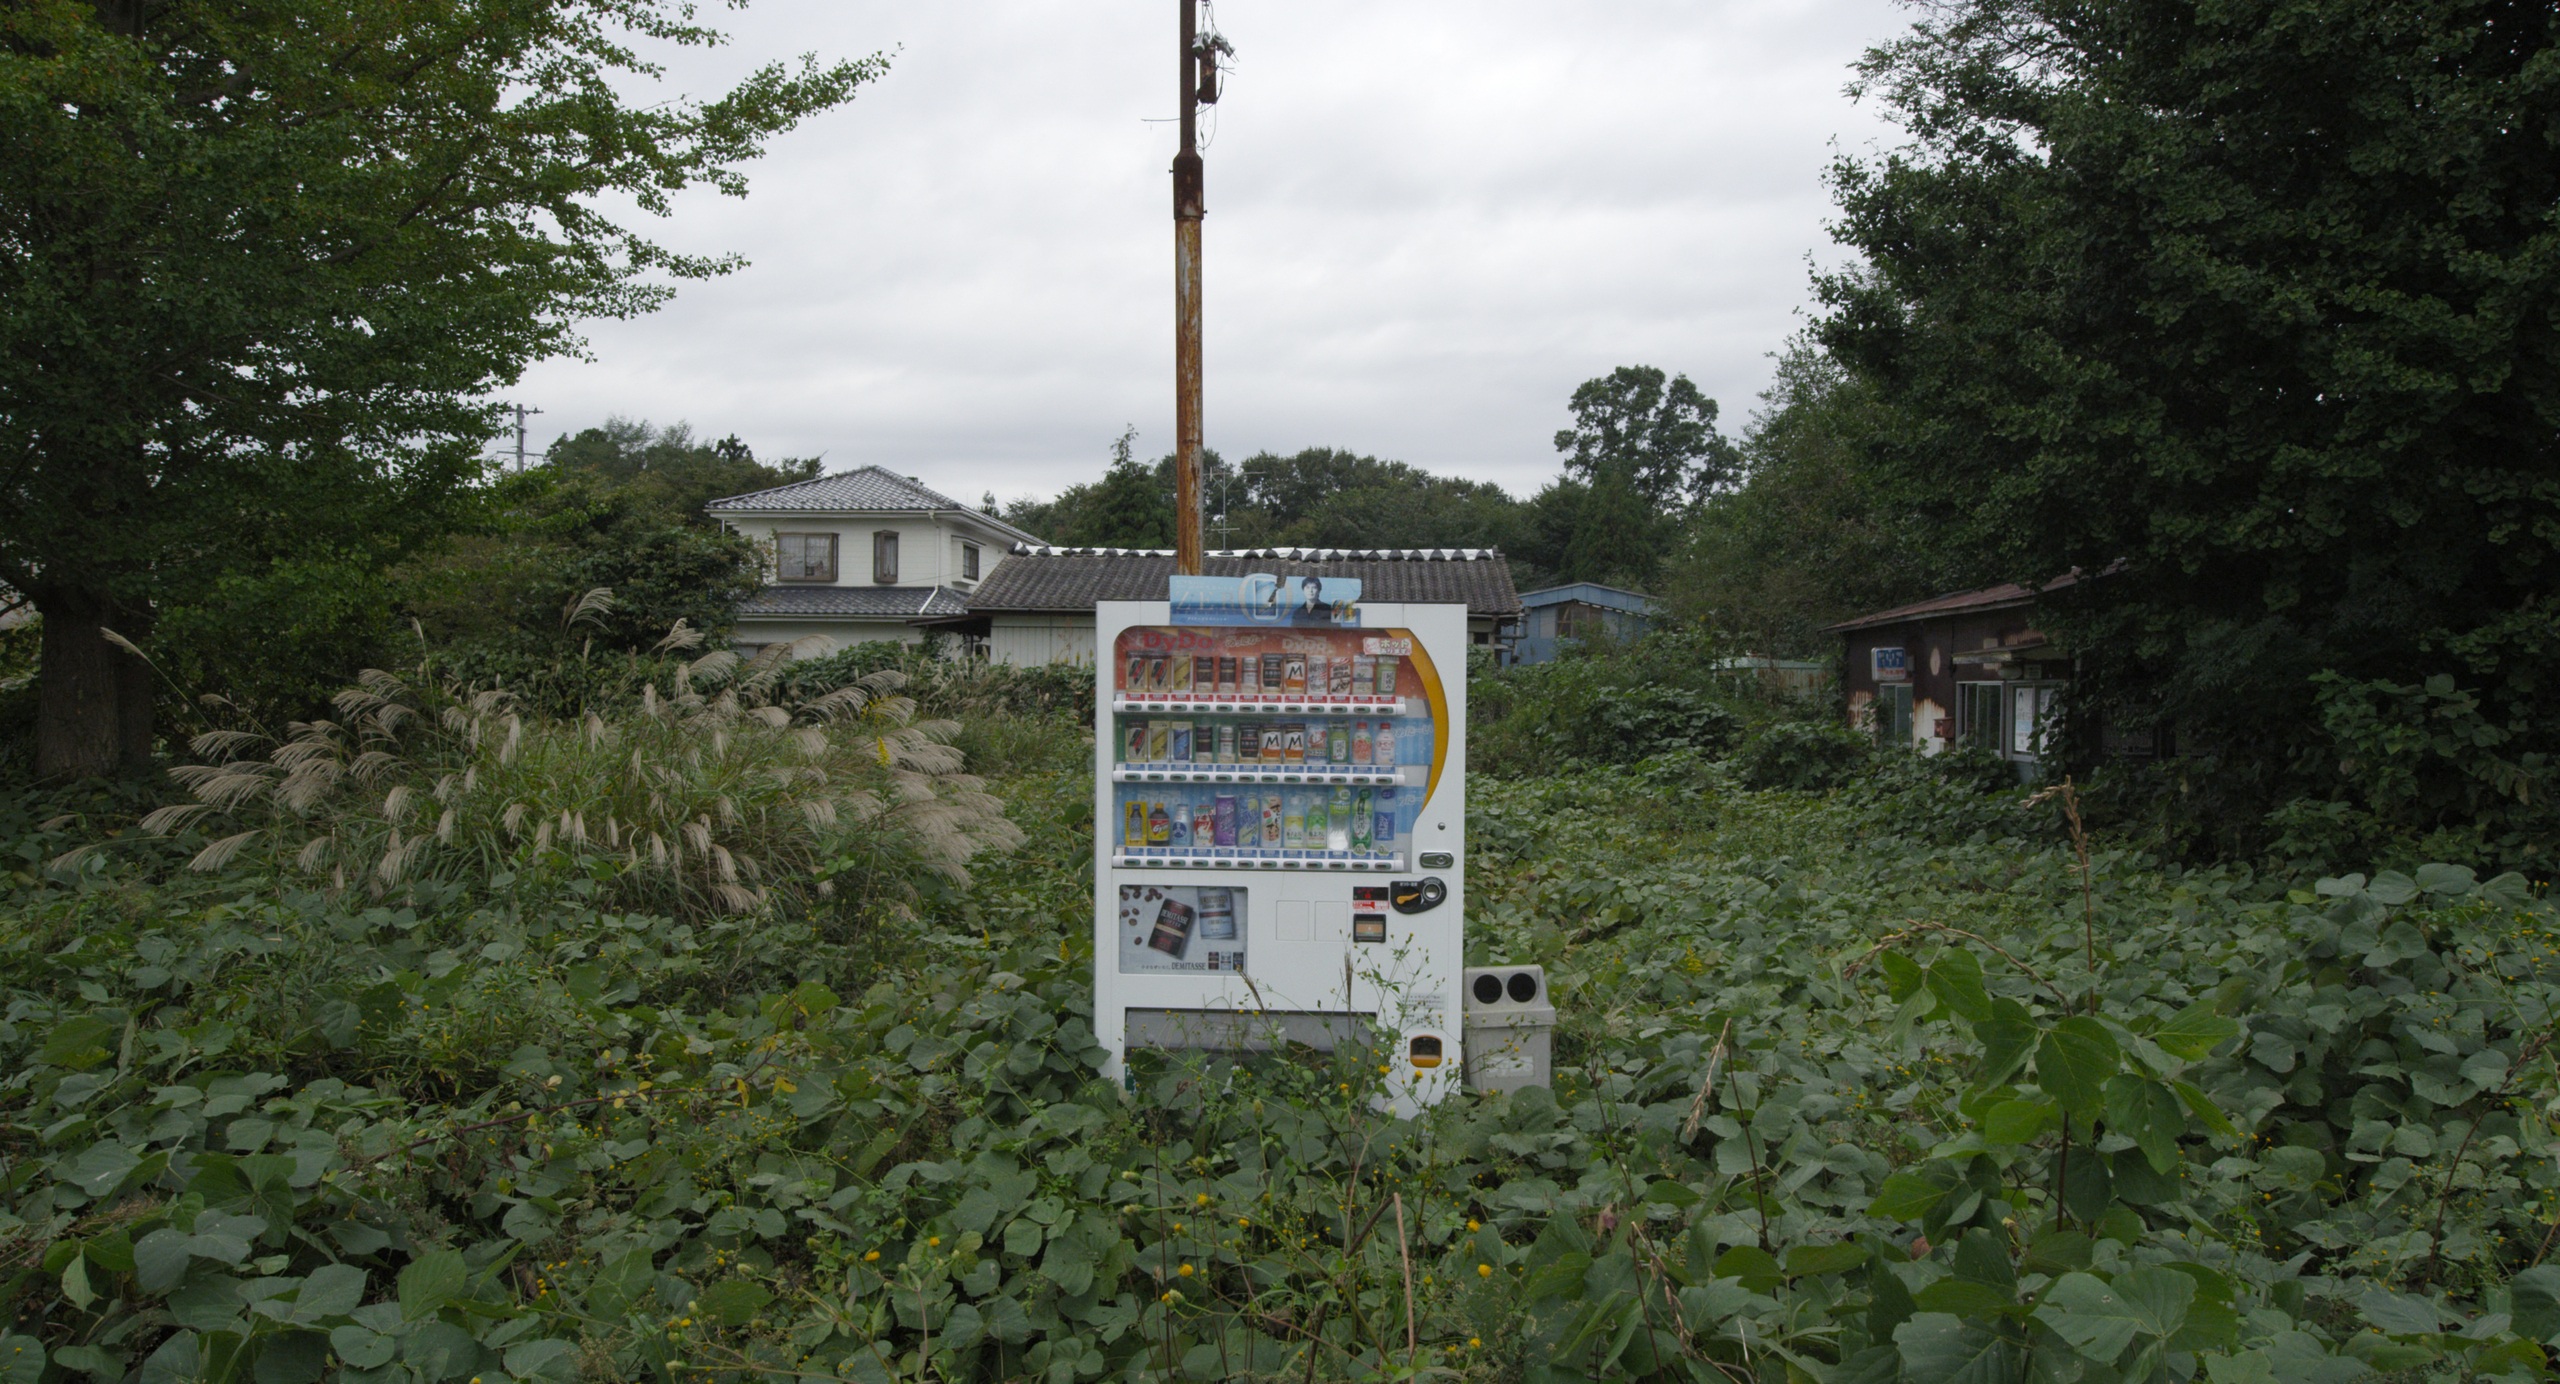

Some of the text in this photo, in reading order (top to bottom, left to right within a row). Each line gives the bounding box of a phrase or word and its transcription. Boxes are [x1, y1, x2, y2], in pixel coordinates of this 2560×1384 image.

[1142, 632, 1213, 651] DyDo
[1380, 639, 1409, 648] ホット
[1171, 962, 1206, 971] DEMITASSE
